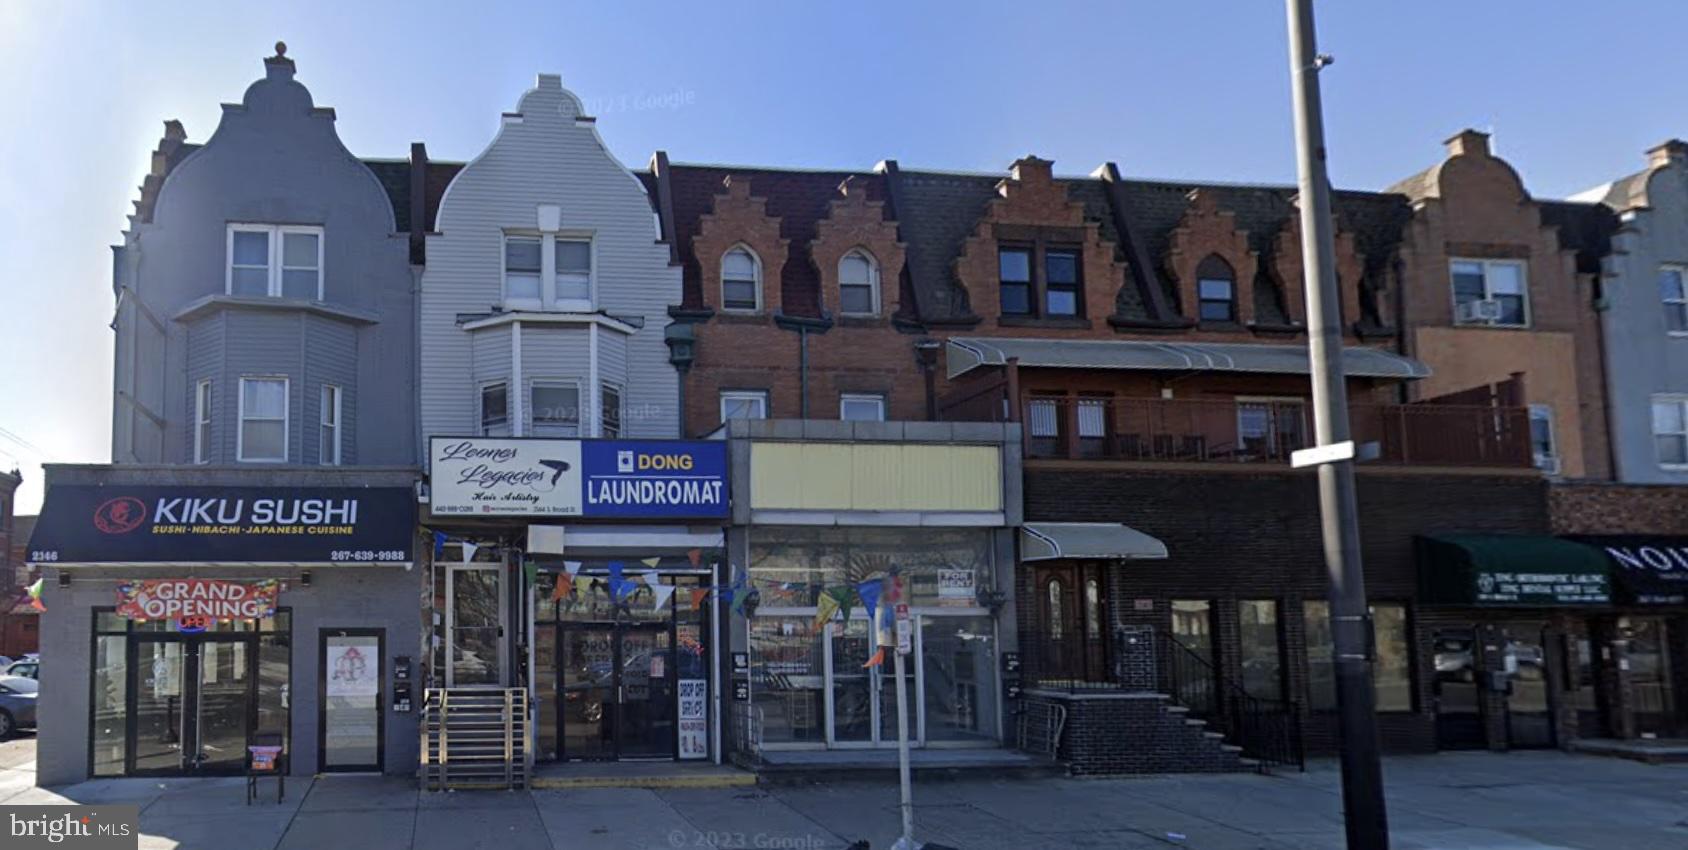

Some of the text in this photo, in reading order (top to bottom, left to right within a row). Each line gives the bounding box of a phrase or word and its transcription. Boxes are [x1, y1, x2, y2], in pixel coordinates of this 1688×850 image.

[439, 442, 518, 463] Leones
[638, 454, 693, 470] DONG
[457, 464, 544, 488] Legacies
[588, 480, 722, 504] LAUNDROMAT
[153, 498, 358, 525] KIKU SUSHI
[307, 526, 354, 535] CUISINE
[156, 582, 246, 600] GRAND
[144, 600, 258, 617] OPENING
